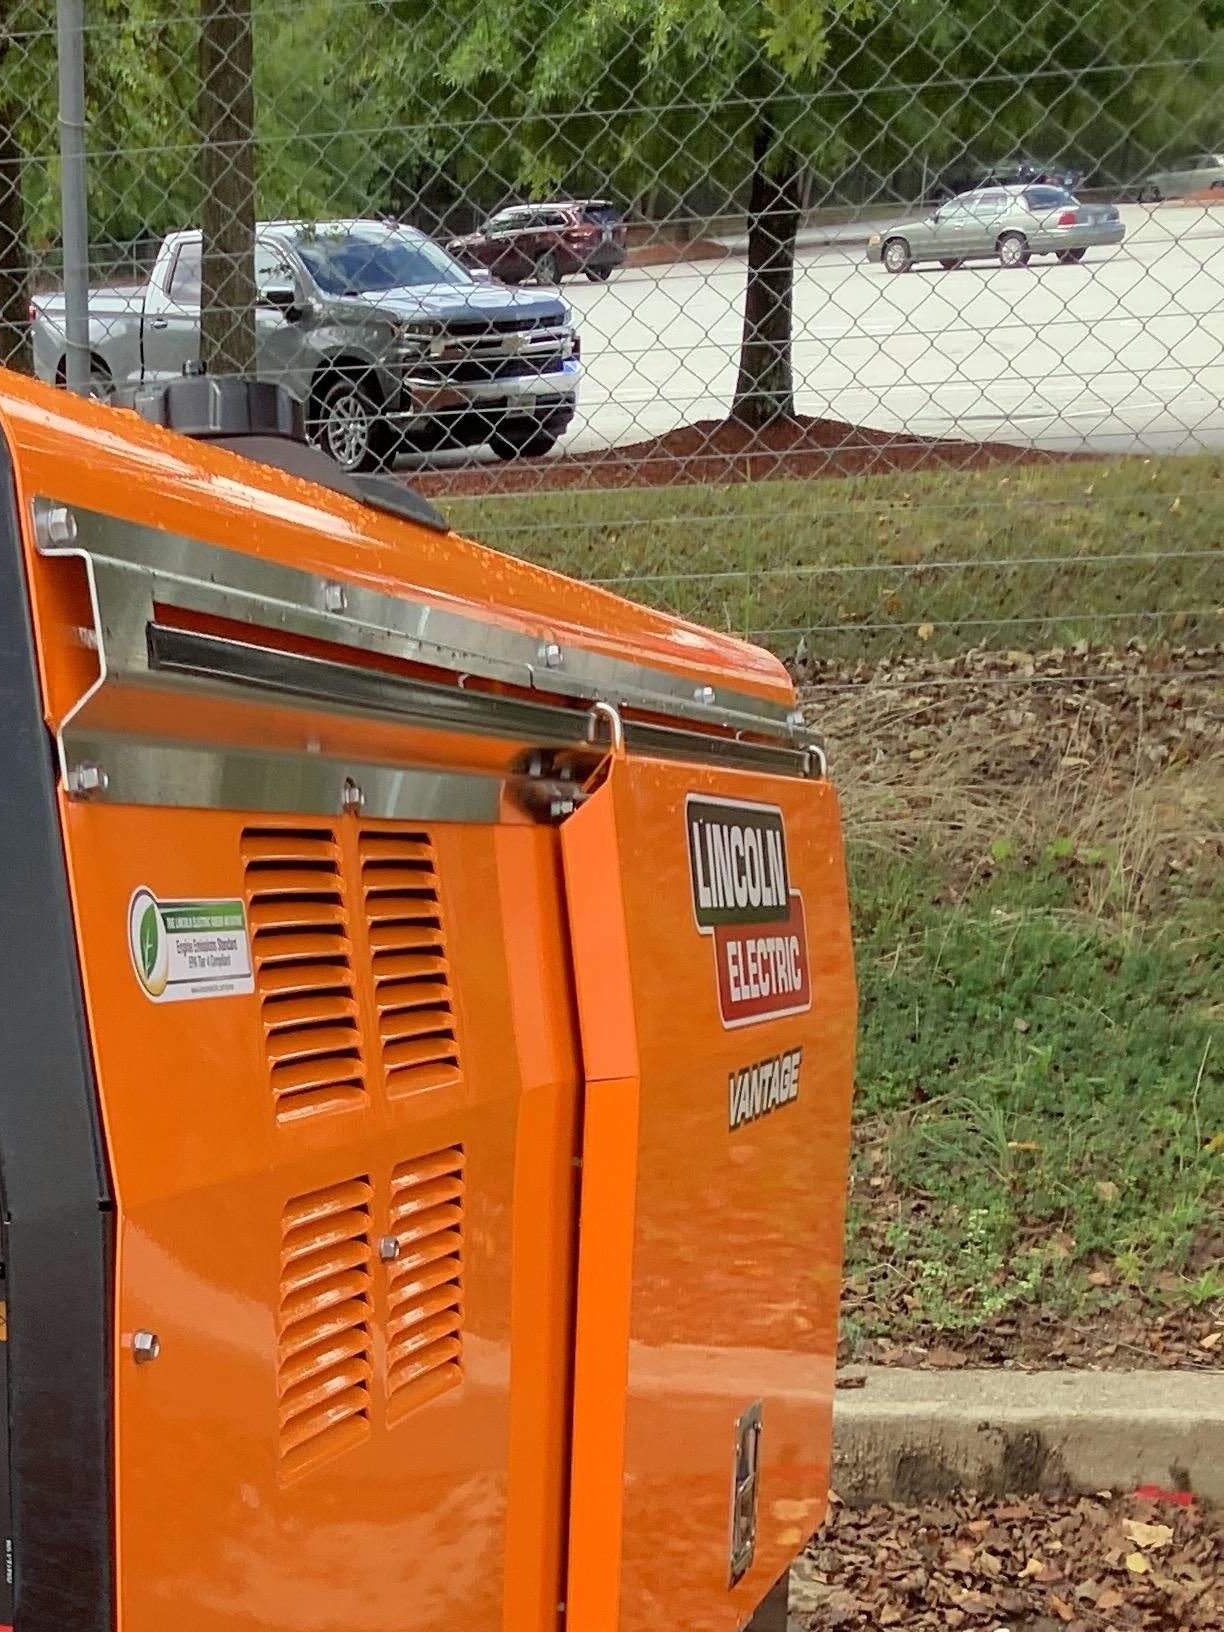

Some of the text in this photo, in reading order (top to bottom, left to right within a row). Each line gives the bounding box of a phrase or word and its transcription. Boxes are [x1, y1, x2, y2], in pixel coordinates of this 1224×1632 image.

[692, 821, 787, 909] LINCOLN
[727, 936, 802, 1002] ELECTRIC
[729, 1048, 802, 1130] VANTAGE
